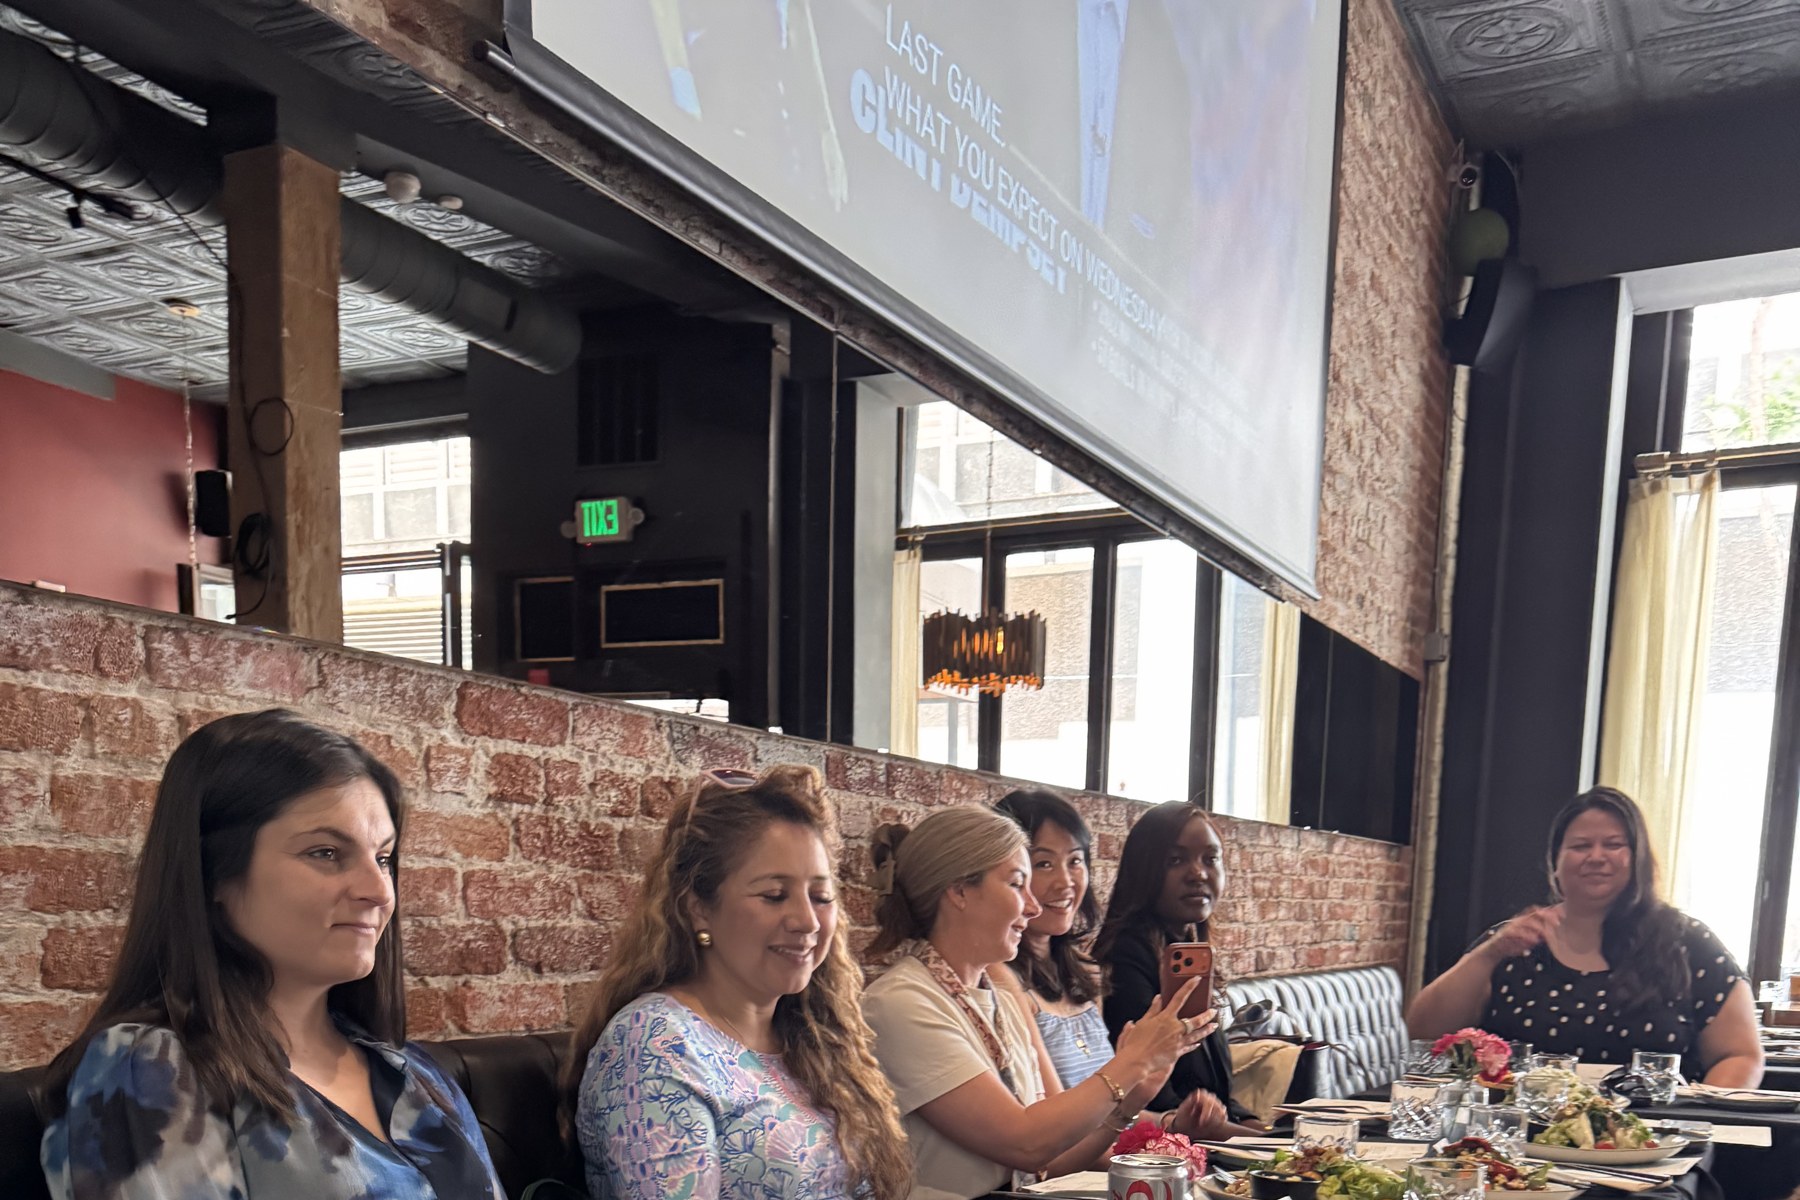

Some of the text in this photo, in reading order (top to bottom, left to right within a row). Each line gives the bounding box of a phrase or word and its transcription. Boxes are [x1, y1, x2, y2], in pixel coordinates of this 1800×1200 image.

[886, 2, 1006, 148] LAST GAME.
[884, 65, 1166, 337] WHAT YOU EXPECT ON WEDNESDAY
